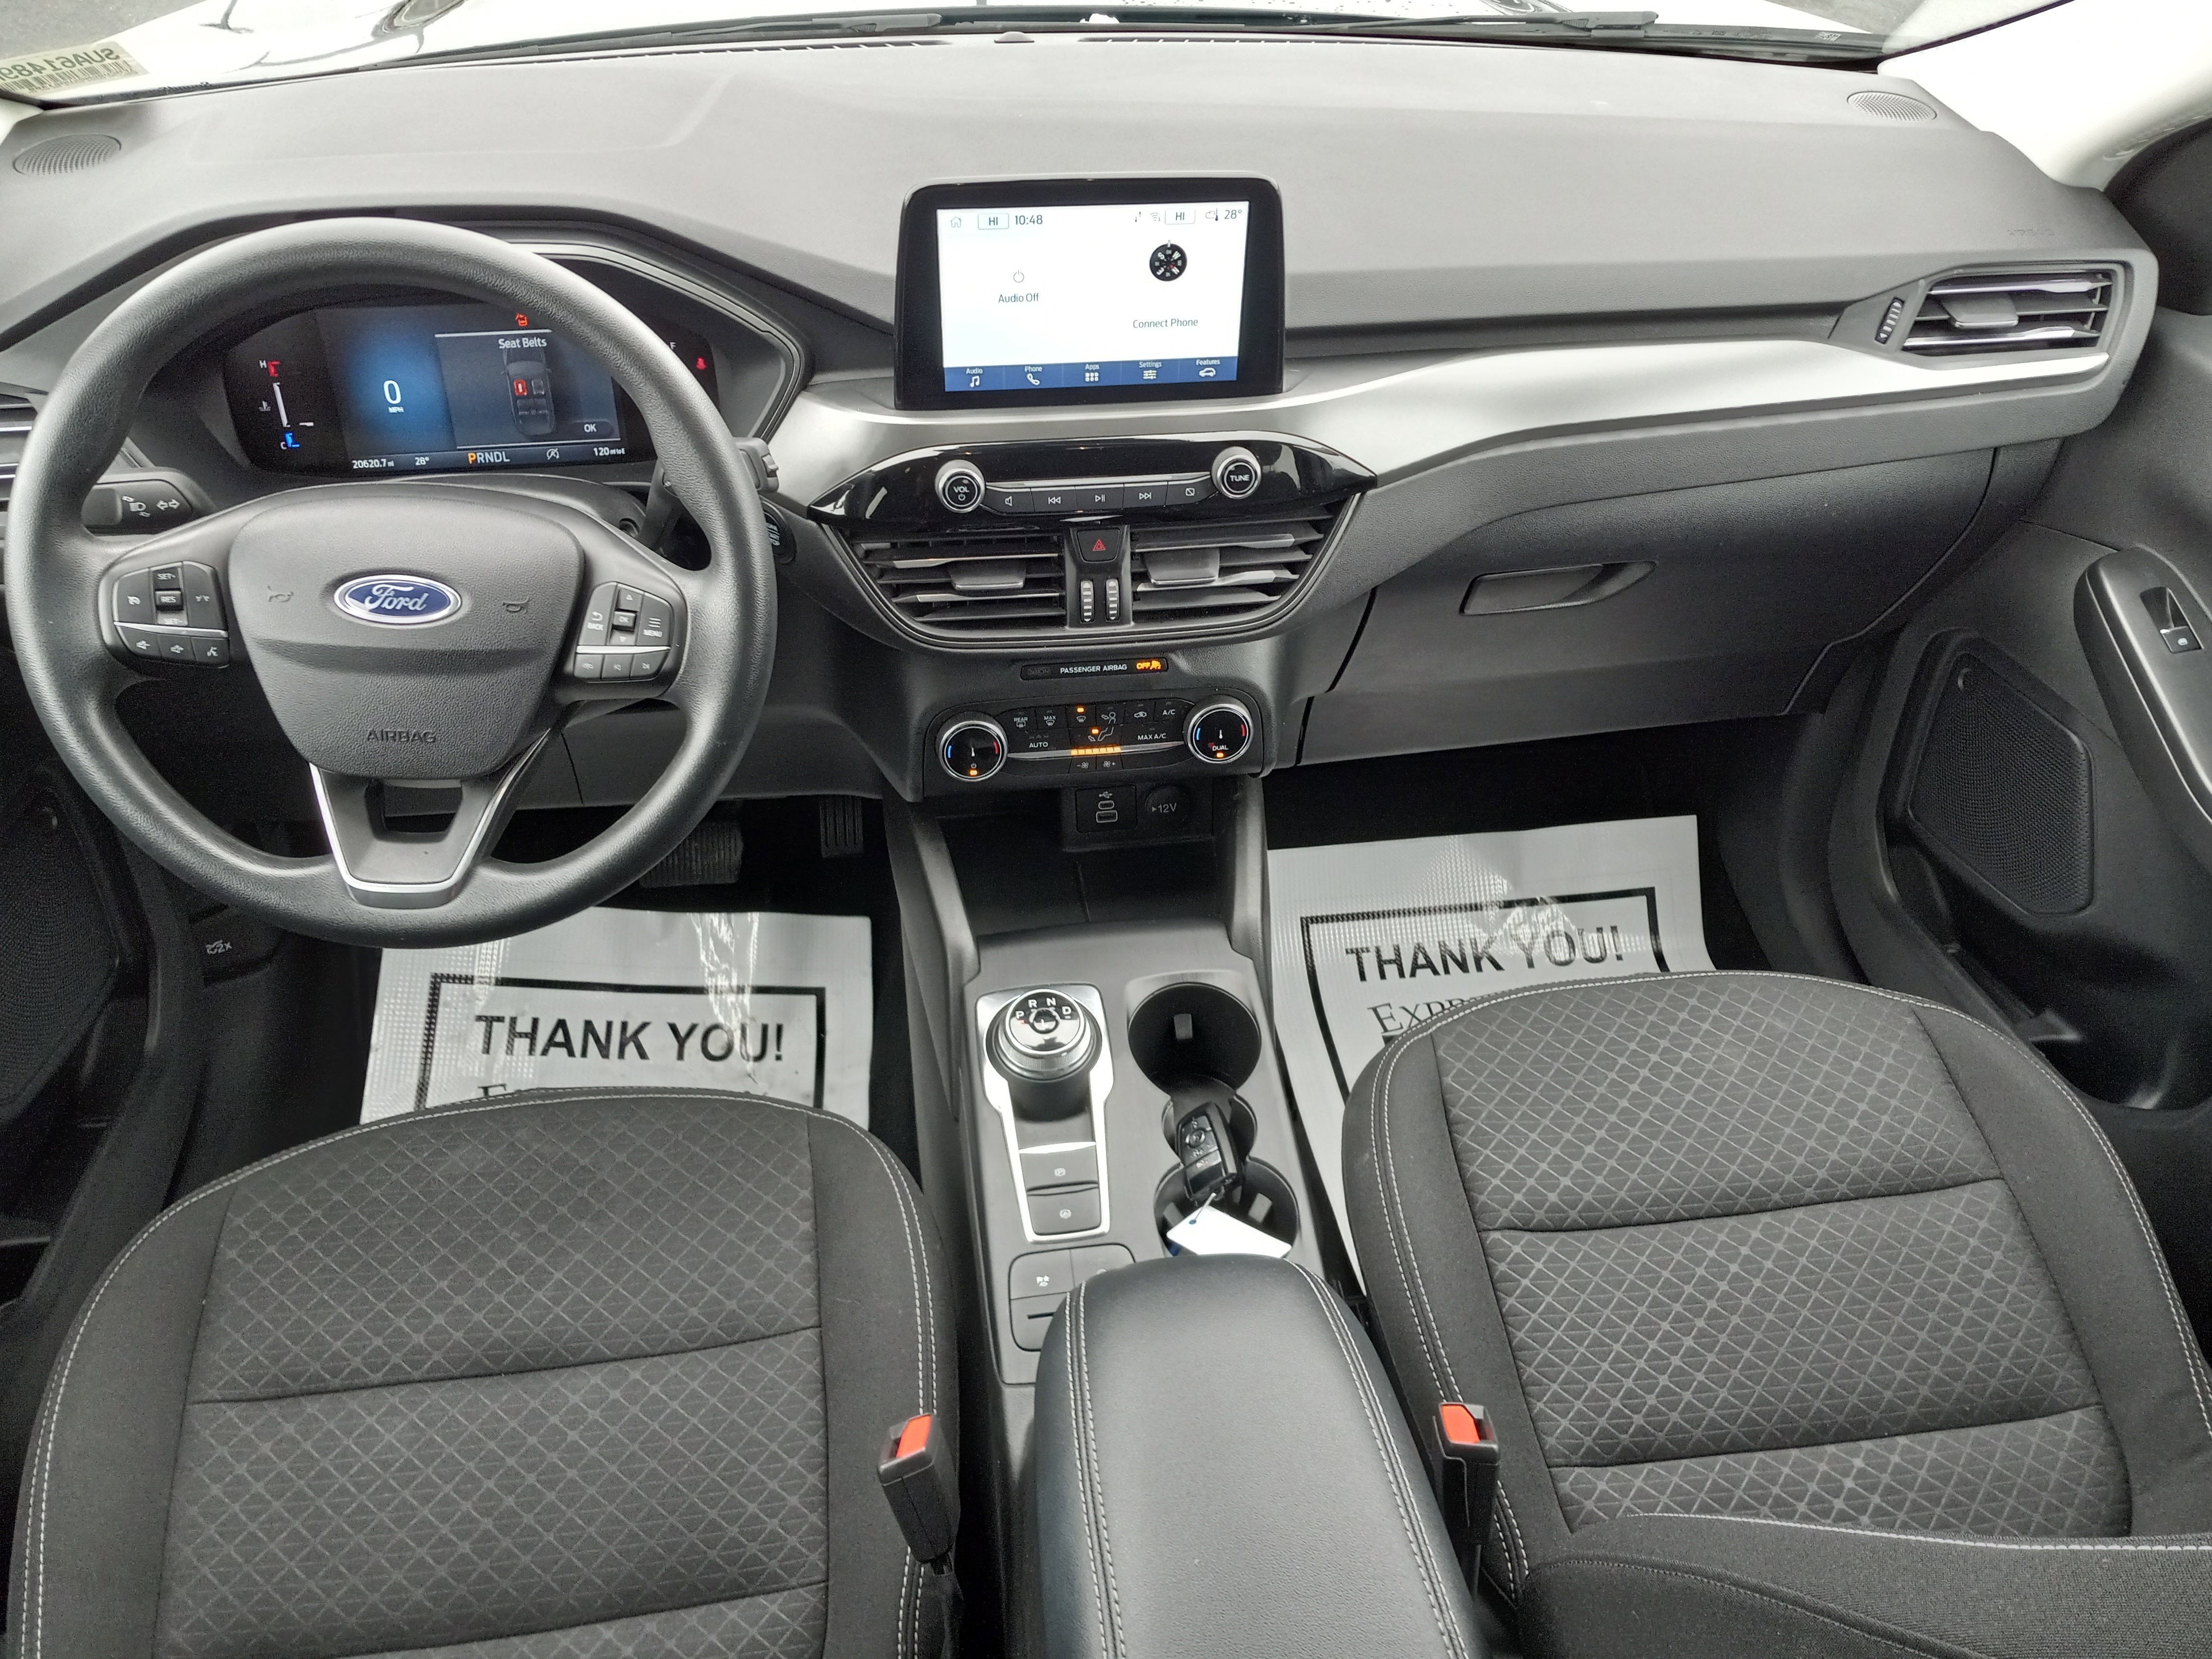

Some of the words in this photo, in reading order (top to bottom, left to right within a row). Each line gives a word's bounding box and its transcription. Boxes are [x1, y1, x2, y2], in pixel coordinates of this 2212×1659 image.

[988, 216, 998, 226] HI
[1015, 215, 1043, 225] 10:48
[1175, 212, 1185, 221] HI
[998, 293, 1024, 303] Audio
[1026, 292, 1040, 302] Off
[1132, 319, 1168, 328] Connect
[1170, 317, 1199, 327] Phone
[498, 338, 521, 349] Seat
[522, 337, 547, 348] Belts
[670, 341, 676, 350] F
[260, 360, 267, 368] H
[1085, 363, 1100, 372] Apps
[1139, 360, 1162, 369] Settings
[383, 380, 401, 404] 0
[584, 423, 596, 432] OK
[593, 447, 610, 456] 120
[468, 452, 510, 464] PRNDL
[352, 458, 386, 469] 20620.7
[364, 584, 429, 611] Ford
[587, 622, 604, 630] BACK
[643, 629, 663, 637] MENU
[1060, 665, 1101, 673] PASSENGER
[367, 729, 436, 743] AIRBAG
[1158, 803, 1177, 813] 12V
[1346, 935, 1505, 982] THANK
[1509, 926, 1623, 969] YOU!
[1028, 999, 1037, 1008] R
[1046, 997, 1057, 1006] N
[1015, 1010, 1025, 1019] P
[1061, 1006, 1072, 1015] D
[475, 1014, 652, 1062] THANK
[667, 1022, 784, 1062] YOU!
